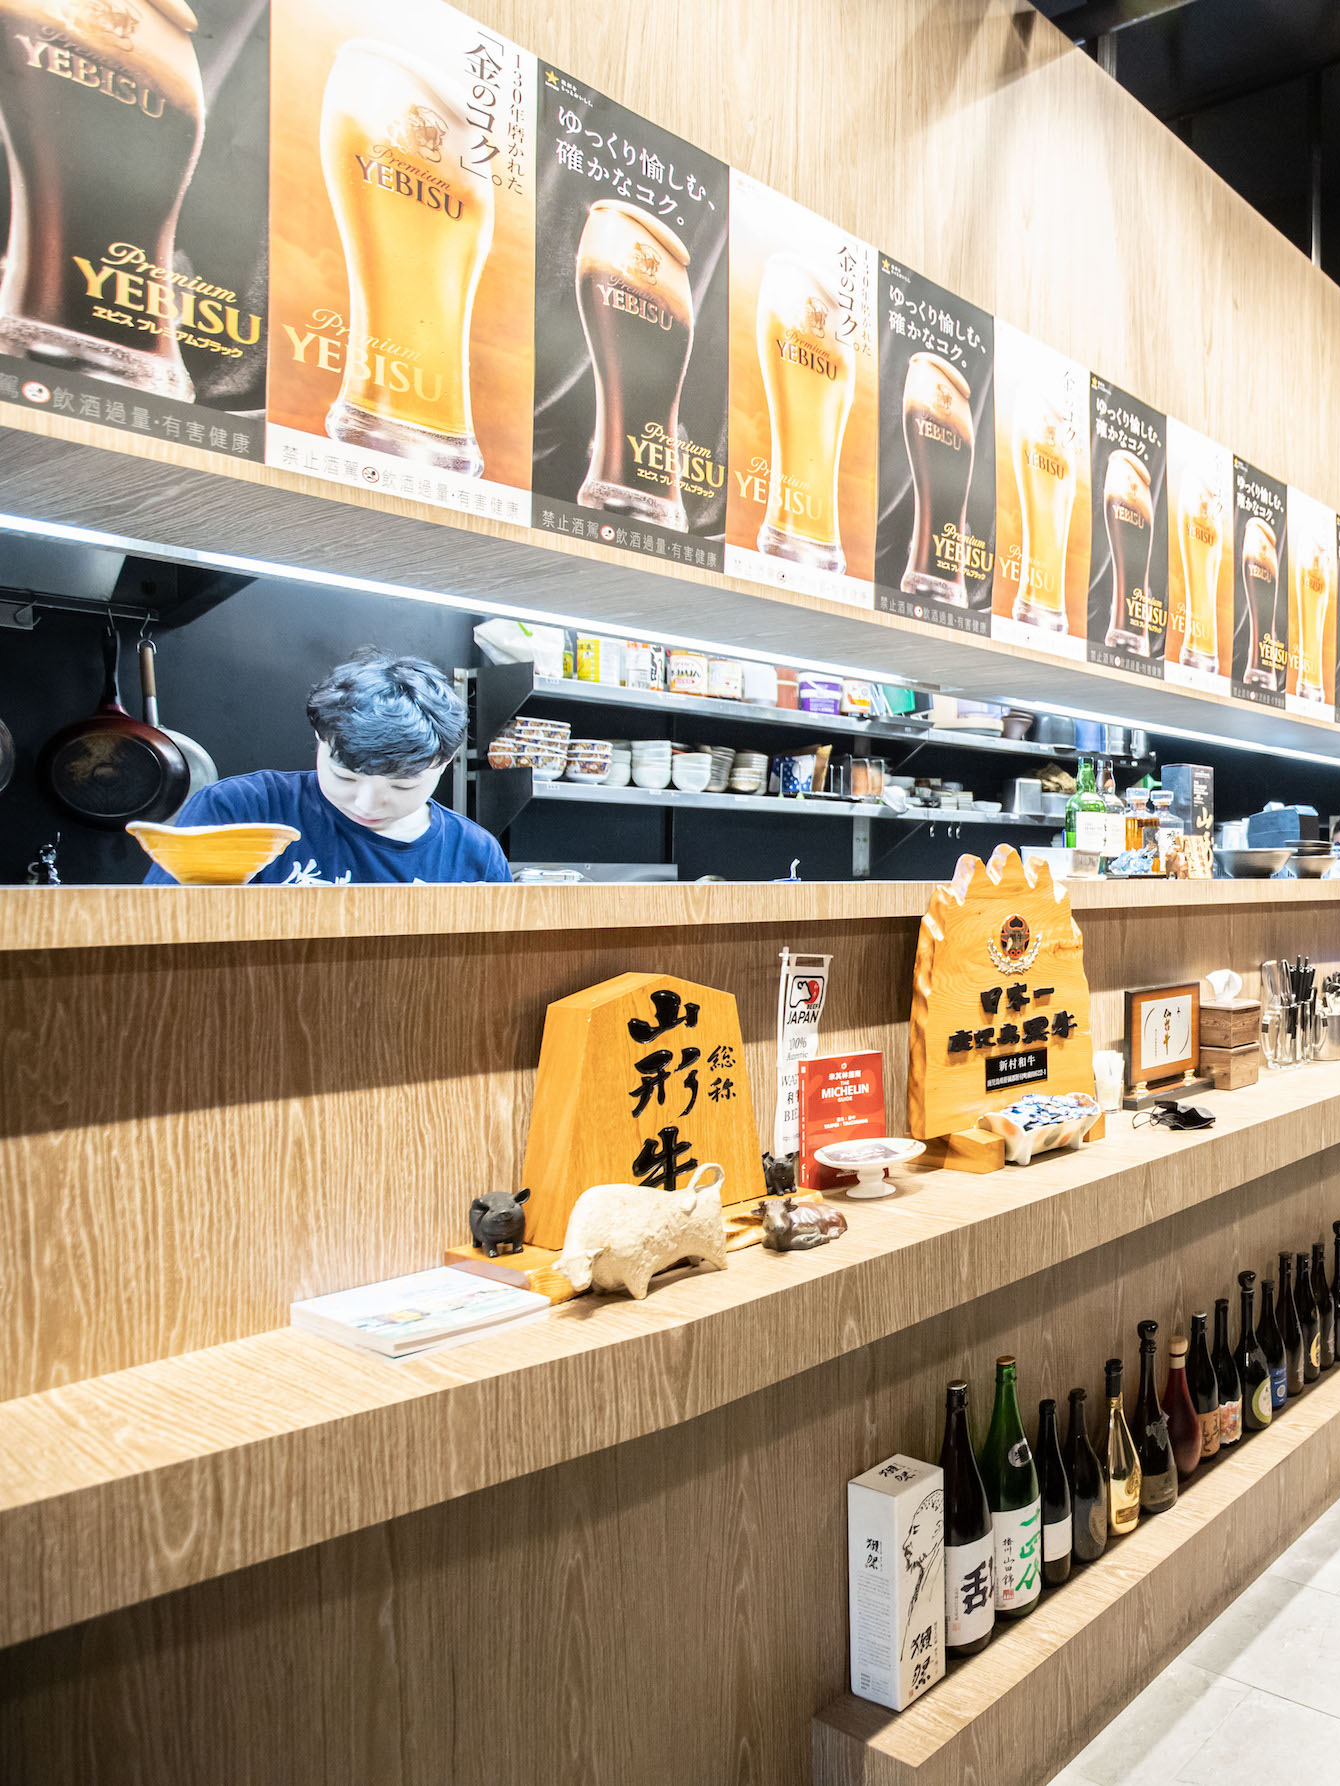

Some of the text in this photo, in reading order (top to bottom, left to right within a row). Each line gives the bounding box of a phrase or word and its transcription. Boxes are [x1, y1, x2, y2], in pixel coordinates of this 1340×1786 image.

[14, 34, 165, 118] YEBISU
[355, 155, 465, 221] YEBISU
[369, 145, 450, 190] Premium
[556, 138, 685, 226] 確かなコク。
[100, 242, 237, 303] Premium
[72, 256, 262, 345] YEBISU
[597, 284, 673, 331] YEBISU
[305, 309, 422, 362] Prmium
[785, 328, 830, 358] Premium
[776, 339, 837, 382] YEBISU
[640, 421, 712, 459] Premium
[915, 417, 962, 451] YEBISU
[626, 434, 726, 489] YEBISU
[1024, 449, 1065, 480] YEBISU
[542, 510, 599, 539] 禁止酒駕
[941, 522, 986, 549] Premium
[932, 534, 994, 572] YEBISU
[1126, 598, 1168, 627] YEBISU
[786, 1010, 820, 1025] JAPAN
[980, 982, 1055, 1014] 日本一
[947, 1010, 1078, 1052] 鹿児島黒牛
[707, 1044, 736, 1103] 総称
[999, 1054, 1036, 1072] 新村和牛
[627, 989, 701, 1191] 山形牛
[821, 1083, 869, 1099] MICHELIN
